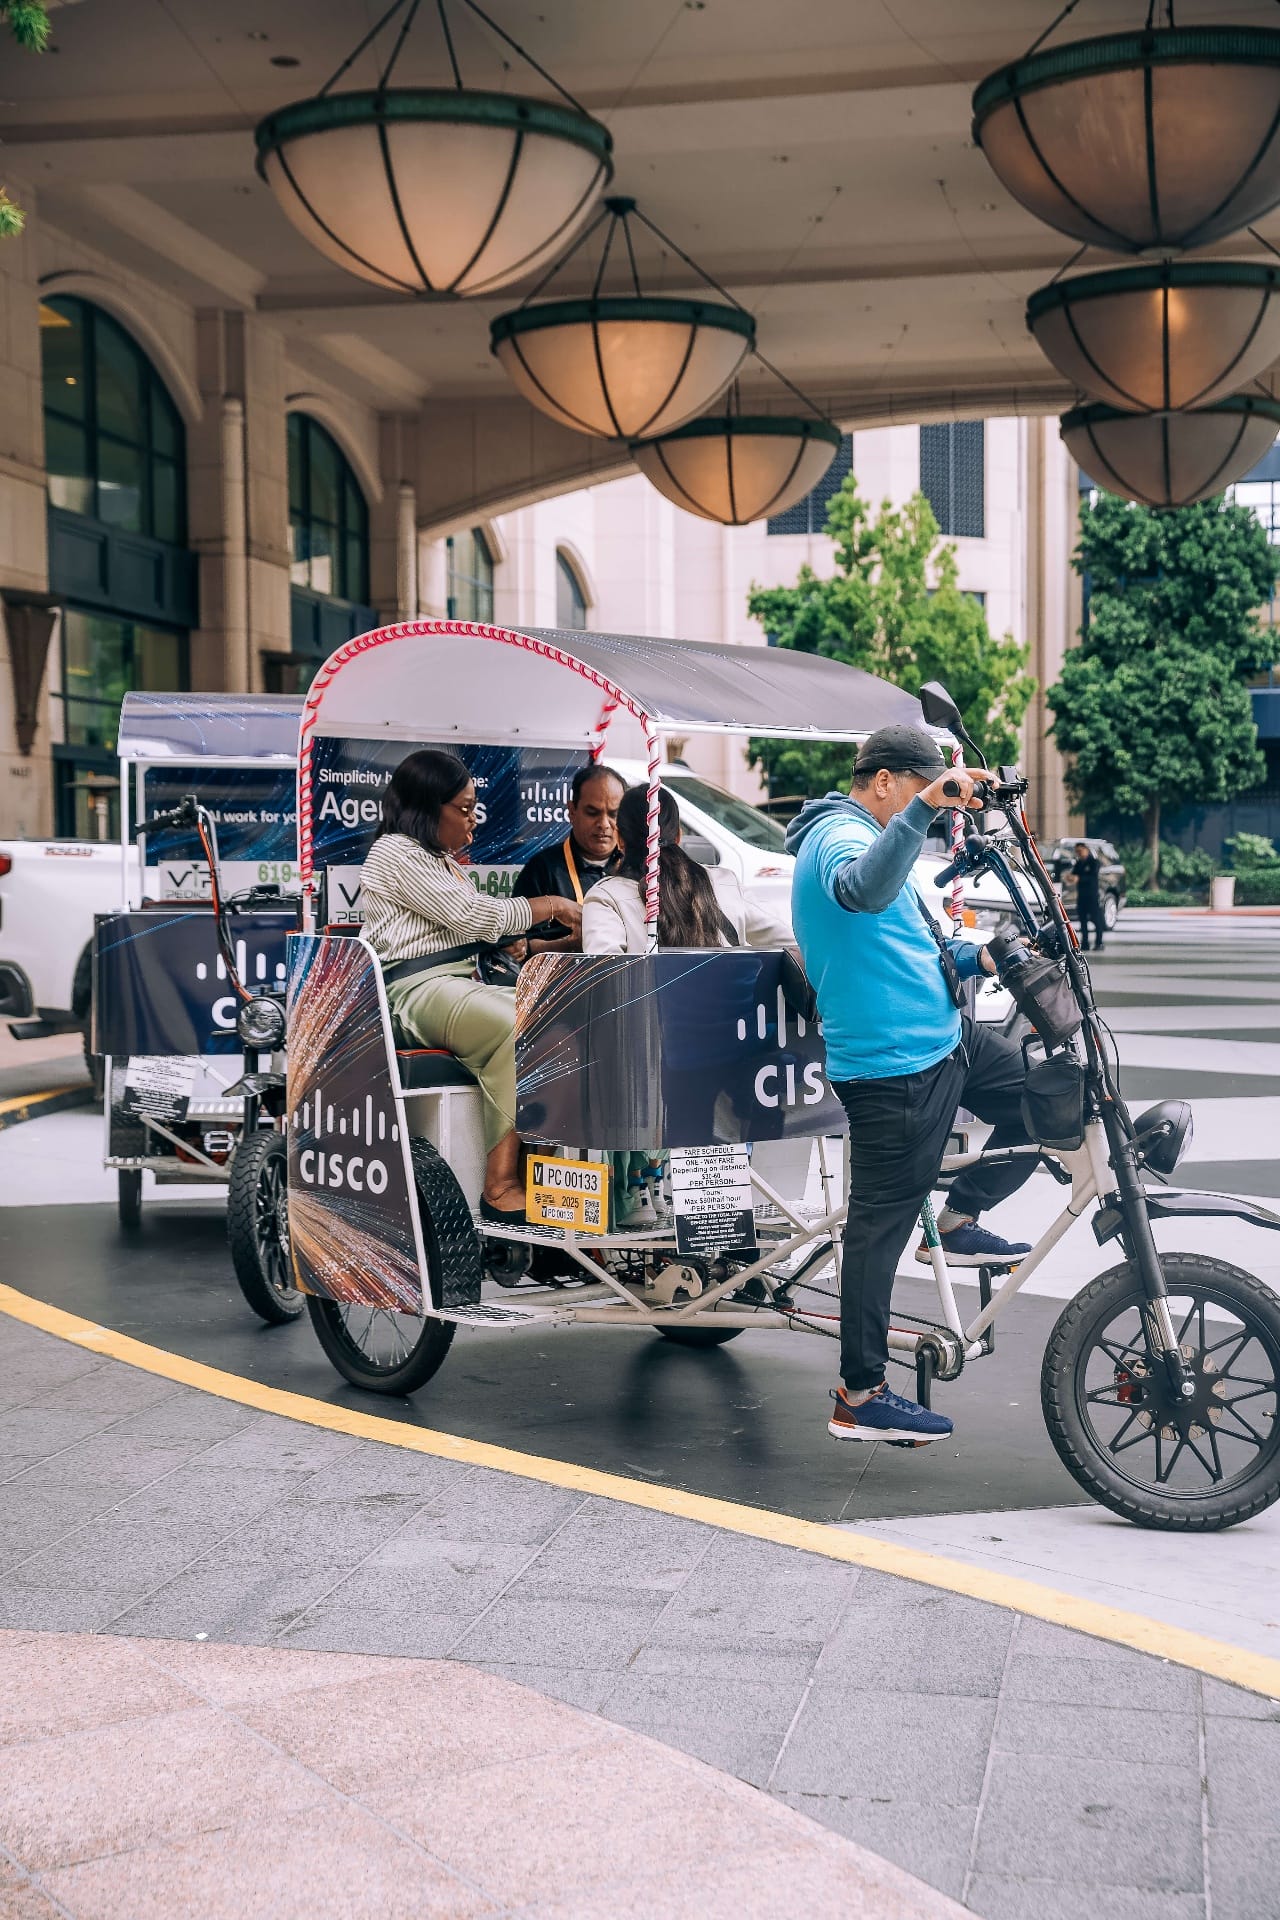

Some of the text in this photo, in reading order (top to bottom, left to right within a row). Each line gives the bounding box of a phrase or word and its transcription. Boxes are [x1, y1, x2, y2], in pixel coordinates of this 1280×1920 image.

[319, 768, 382, 787] Simplicity
[223, 810, 258, 823] work
[260, 810, 279, 822] for
[282, 812, 298, 826] yo
[165, 889, 230, 899] PEDICB
[754, 1062, 841, 1108] CIS
[701, 1146, 735, 1155] SCHEDULE
[299, 1149, 389, 1195] CISCO
[534, 1165, 598, 1191] V PC 00133
[672, 1166, 708, 1175] Depending
[561, 1196, 580, 1208] 2025
